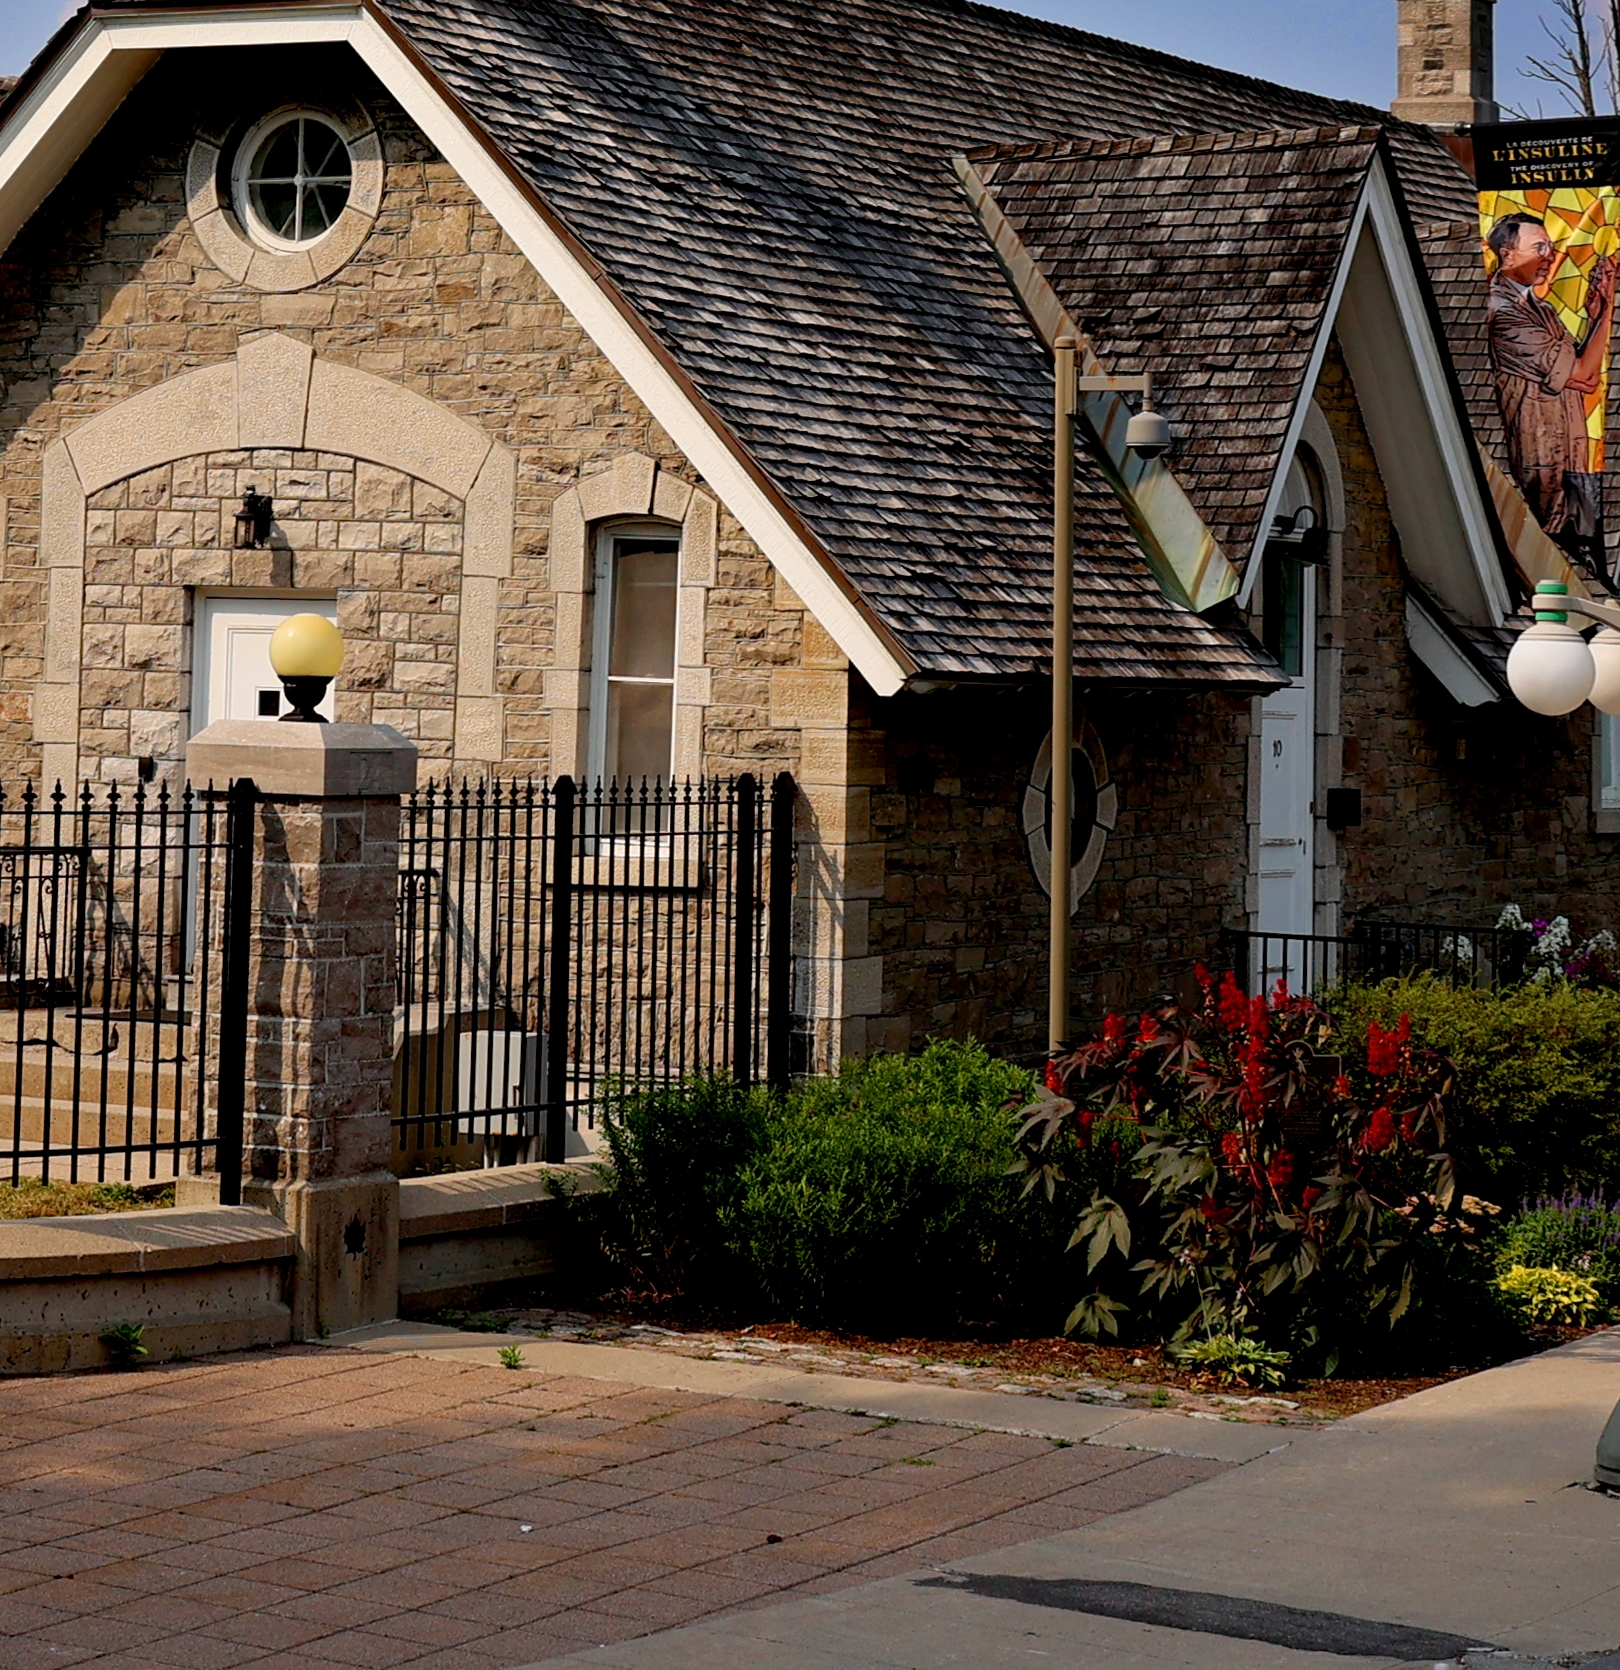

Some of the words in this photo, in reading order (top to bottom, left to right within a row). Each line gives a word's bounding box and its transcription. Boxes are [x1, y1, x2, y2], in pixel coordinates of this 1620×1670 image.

[1492, 143, 1608, 161] L'INSULINE
[1530, 162, 1579, 171] DISCOVERY
[1511, 168, 1595, 184] INSULIN
[1272, 739, 1282, 758] 10
